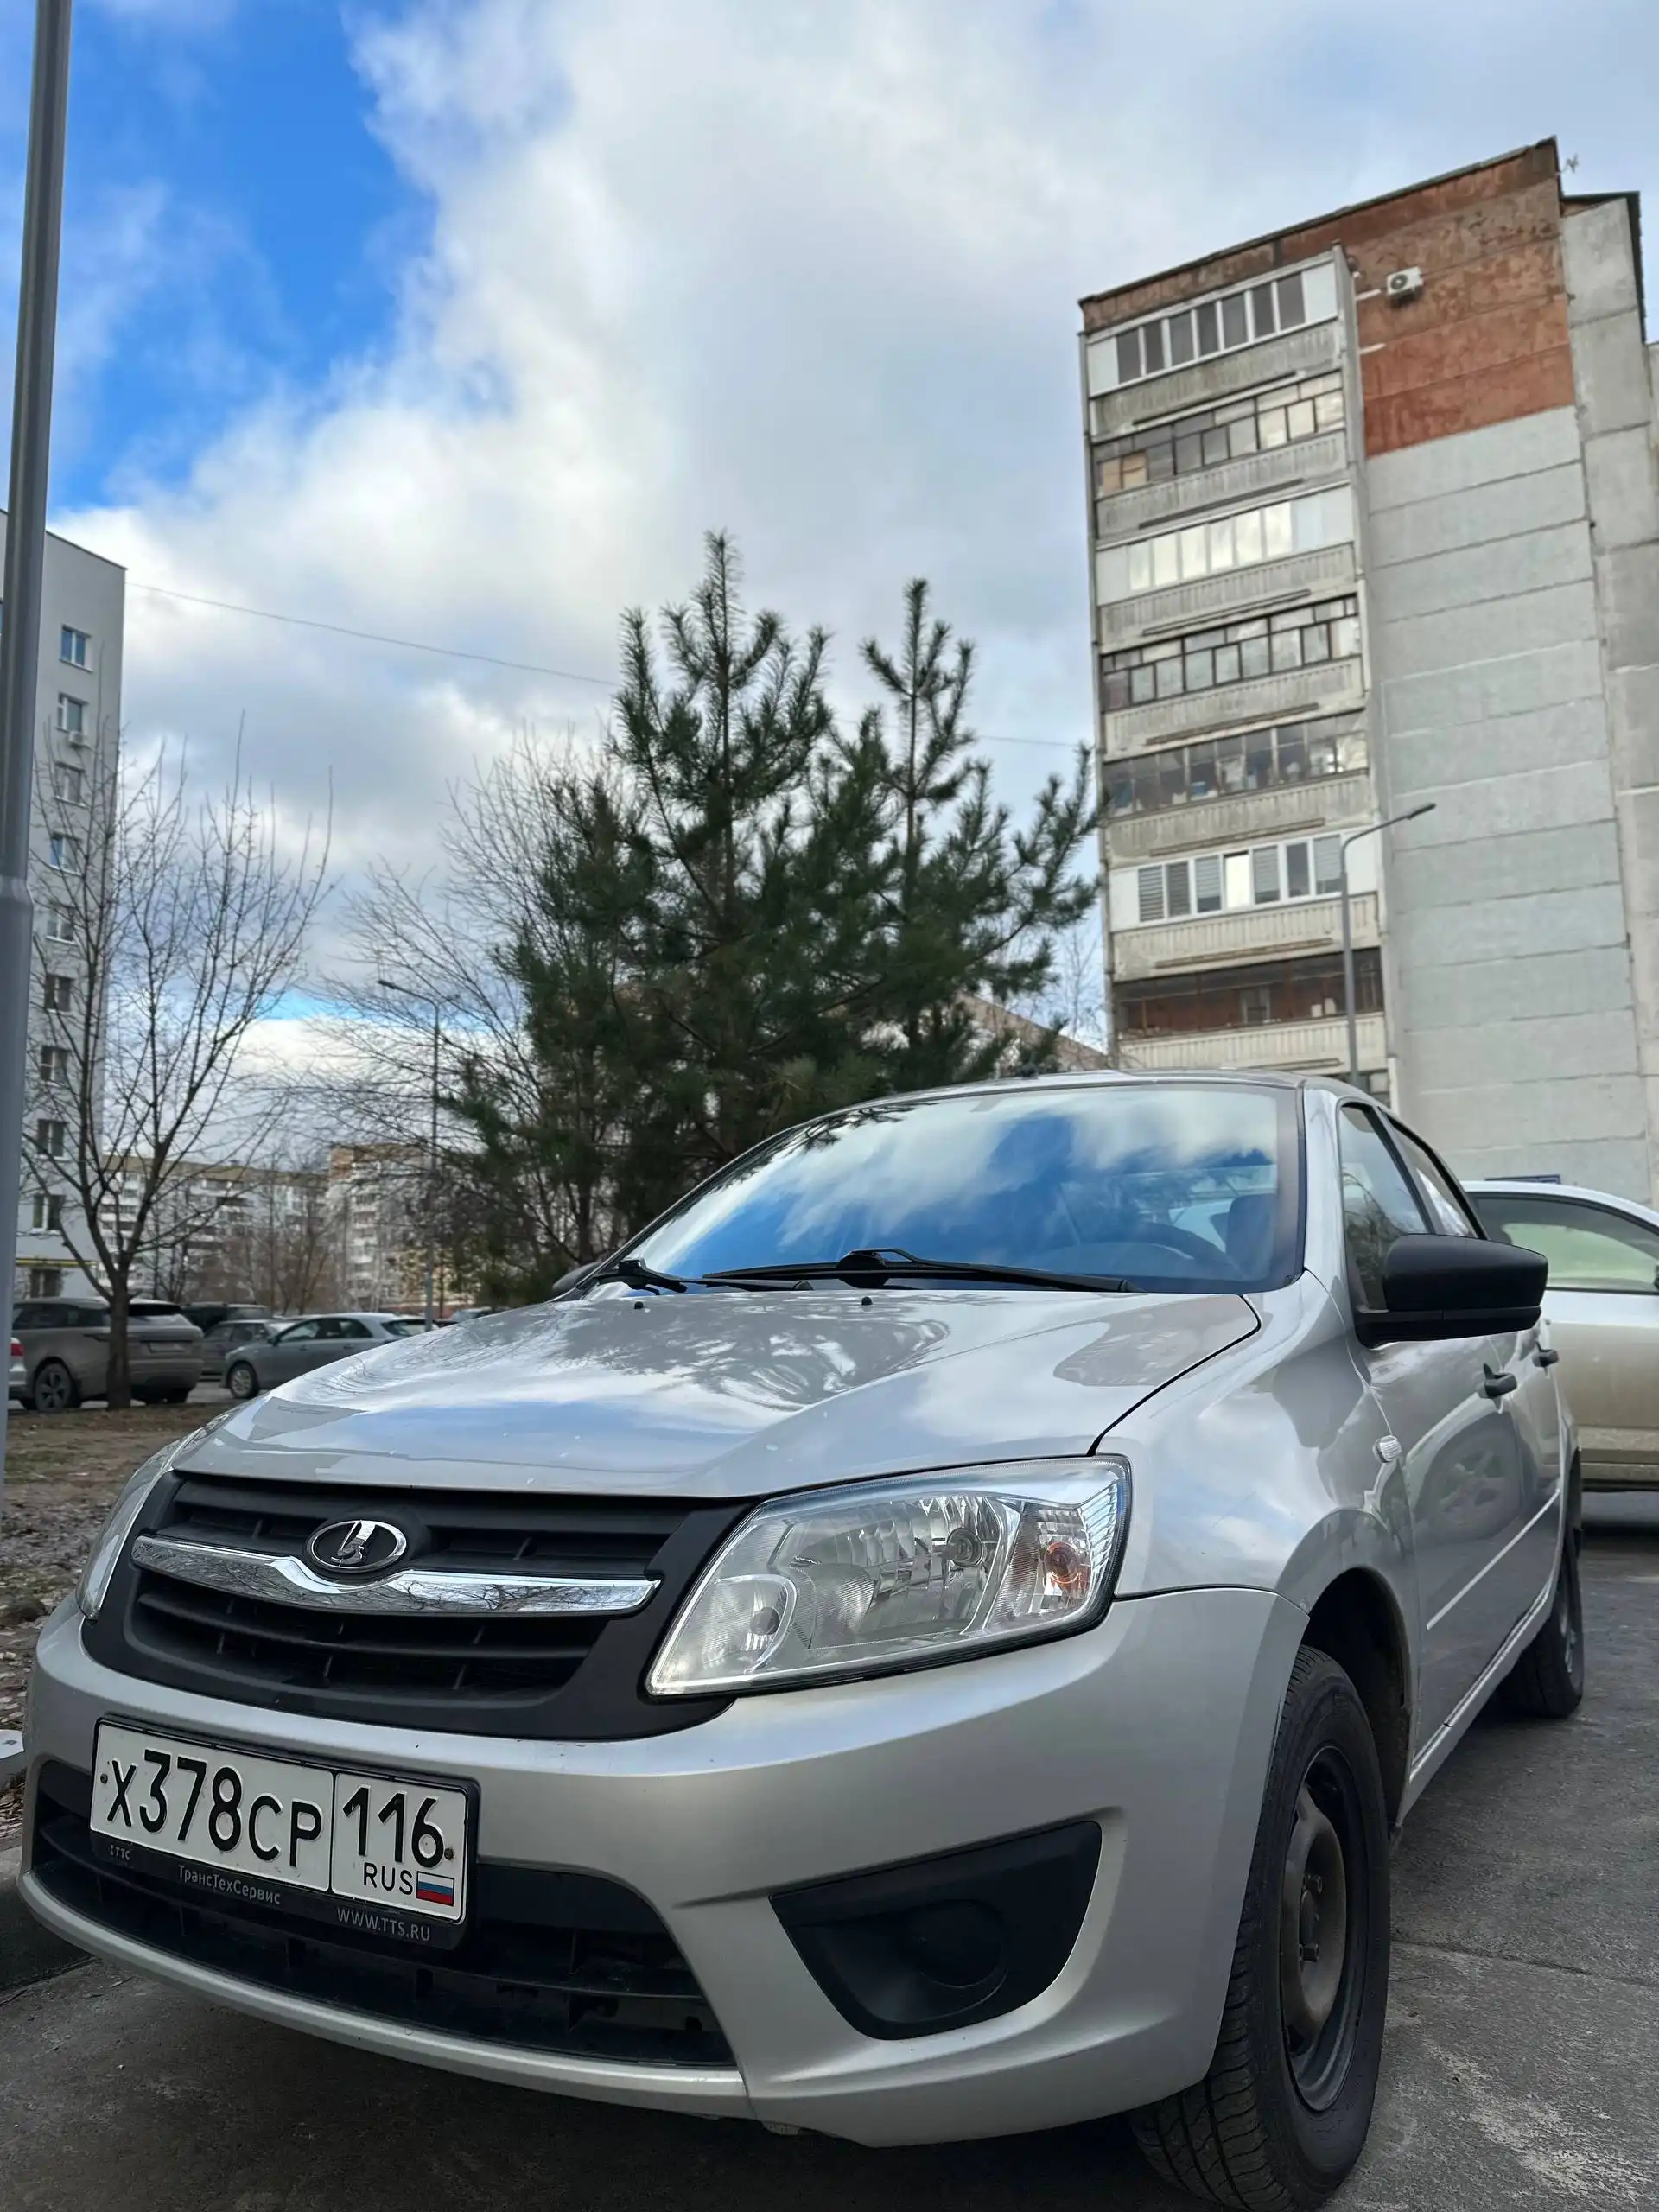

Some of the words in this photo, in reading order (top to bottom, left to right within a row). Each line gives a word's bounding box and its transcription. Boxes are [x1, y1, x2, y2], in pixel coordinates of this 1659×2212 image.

[107, 1749, 322, 1867] Х378СР
[342, 1786, 444, 1868] 116
[177, 1863, 282, 1905] ТрансТехСервис
[363, 1861, 413, 1895] RUS
[337, 1905, 431, 1942] WWW.TTS.RU
